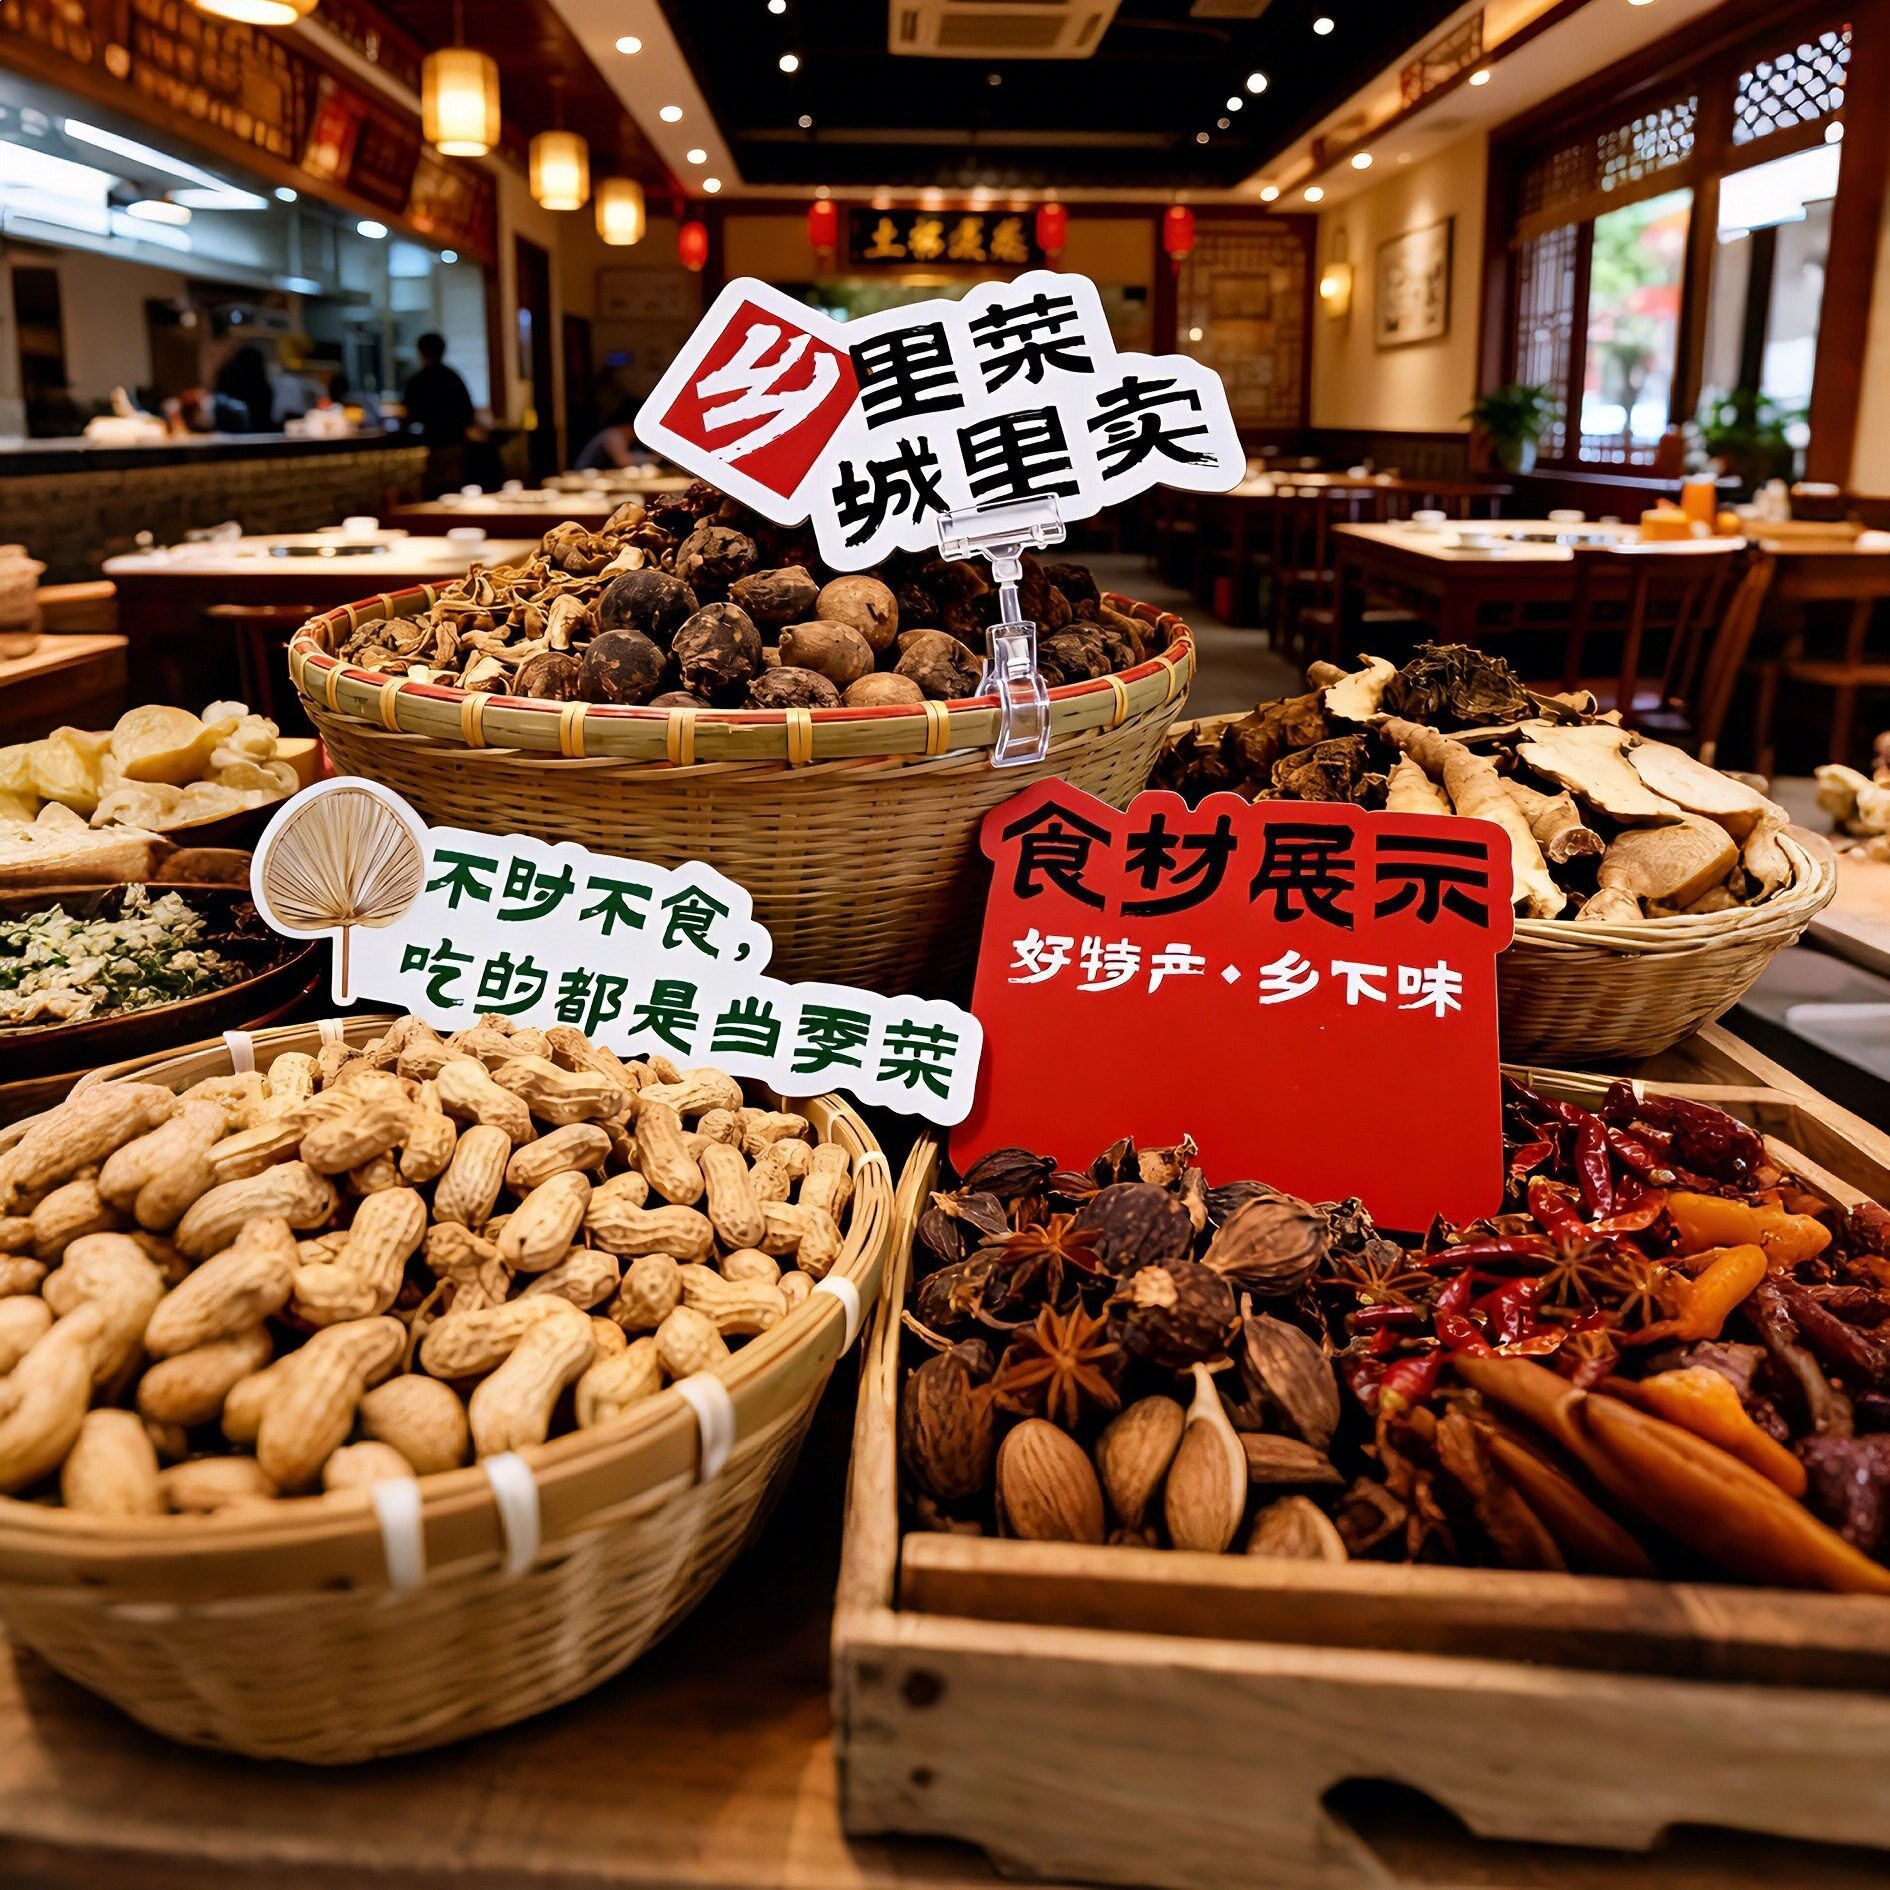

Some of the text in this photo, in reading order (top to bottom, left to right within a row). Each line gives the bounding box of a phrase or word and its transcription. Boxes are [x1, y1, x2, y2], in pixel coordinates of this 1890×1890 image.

[832, 376, 1220, 548] 城里卖
[1002, 800, 1490, 931] 食材展示
[399, 937, 961, 1100] 吃的都是当季菜
